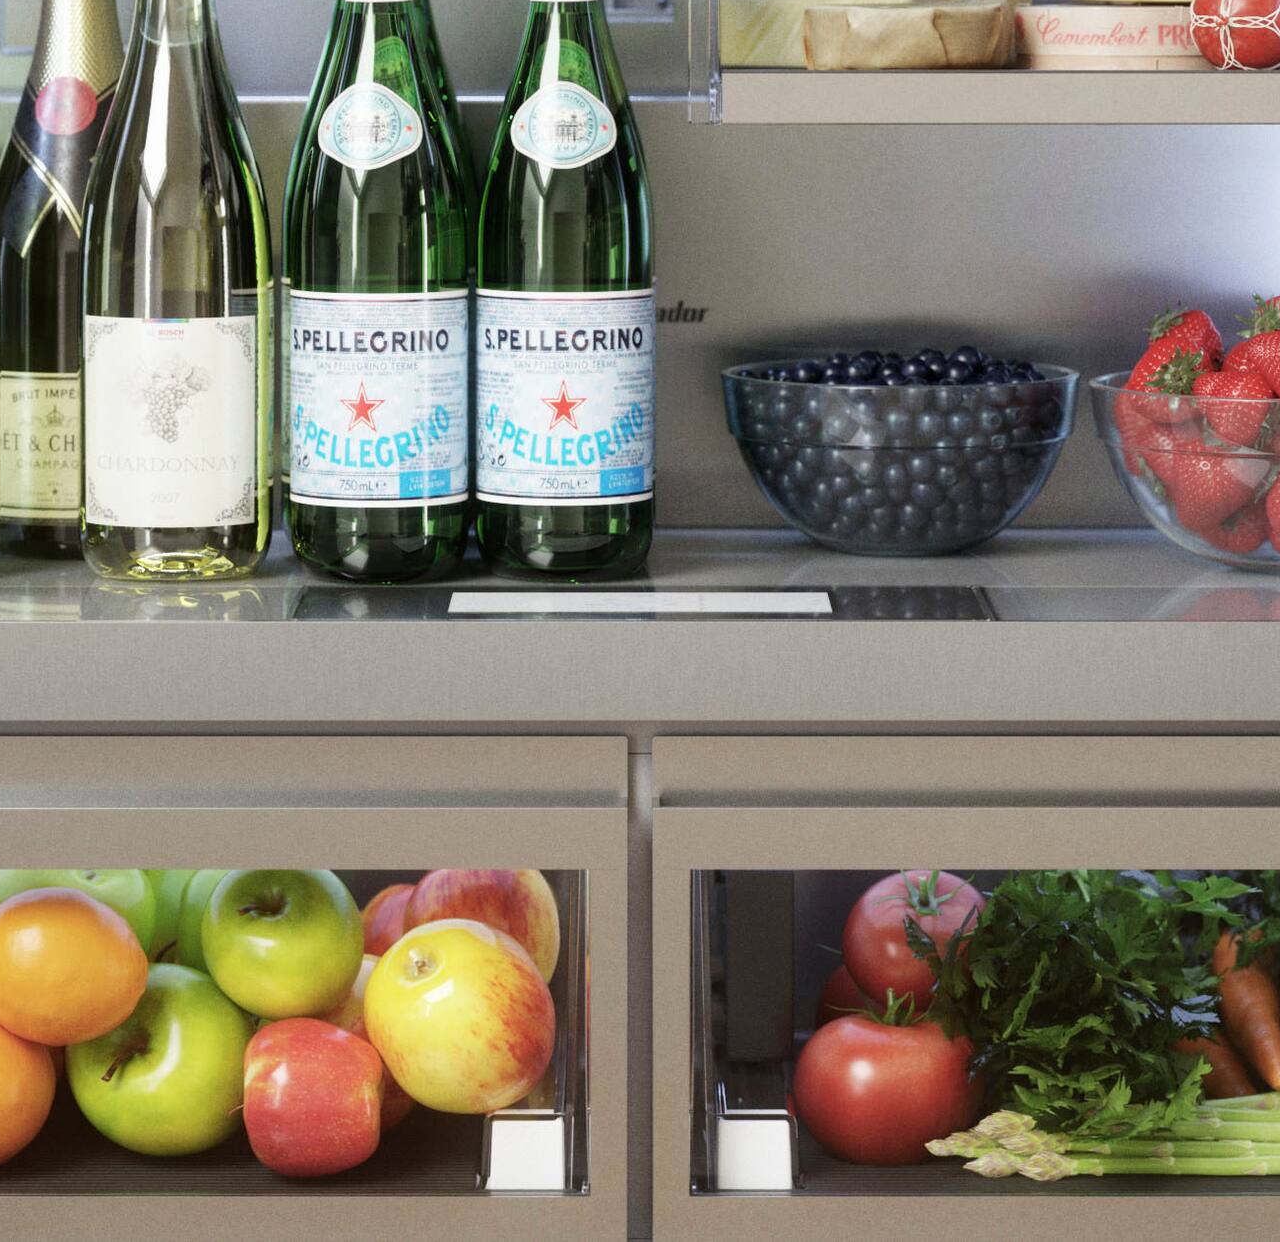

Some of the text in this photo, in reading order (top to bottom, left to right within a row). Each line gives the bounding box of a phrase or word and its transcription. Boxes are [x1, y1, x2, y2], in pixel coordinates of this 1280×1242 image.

[1036, 13, 1148, 47] Camembert
[293, 328, 449, 353] S.PELLEGRINO
[484, 326, 643, 351] S.PELLEGRINO
[12, 388, 77, 403] BRUT IMPÉ
[29, 435, 42, 453] &
[48, 434, 76, 453] CH
[293, 404, 450, 469] S.PELLEGRINO
[484, 401, 644, 467] S.PELLEGRINO
[16, 459, 80, 471] CHAMPAG
[96, 455, 241, 473] CHARDONNAY
[339, 478, 357, 490] 750
[538, 477, 559, 490] 750
